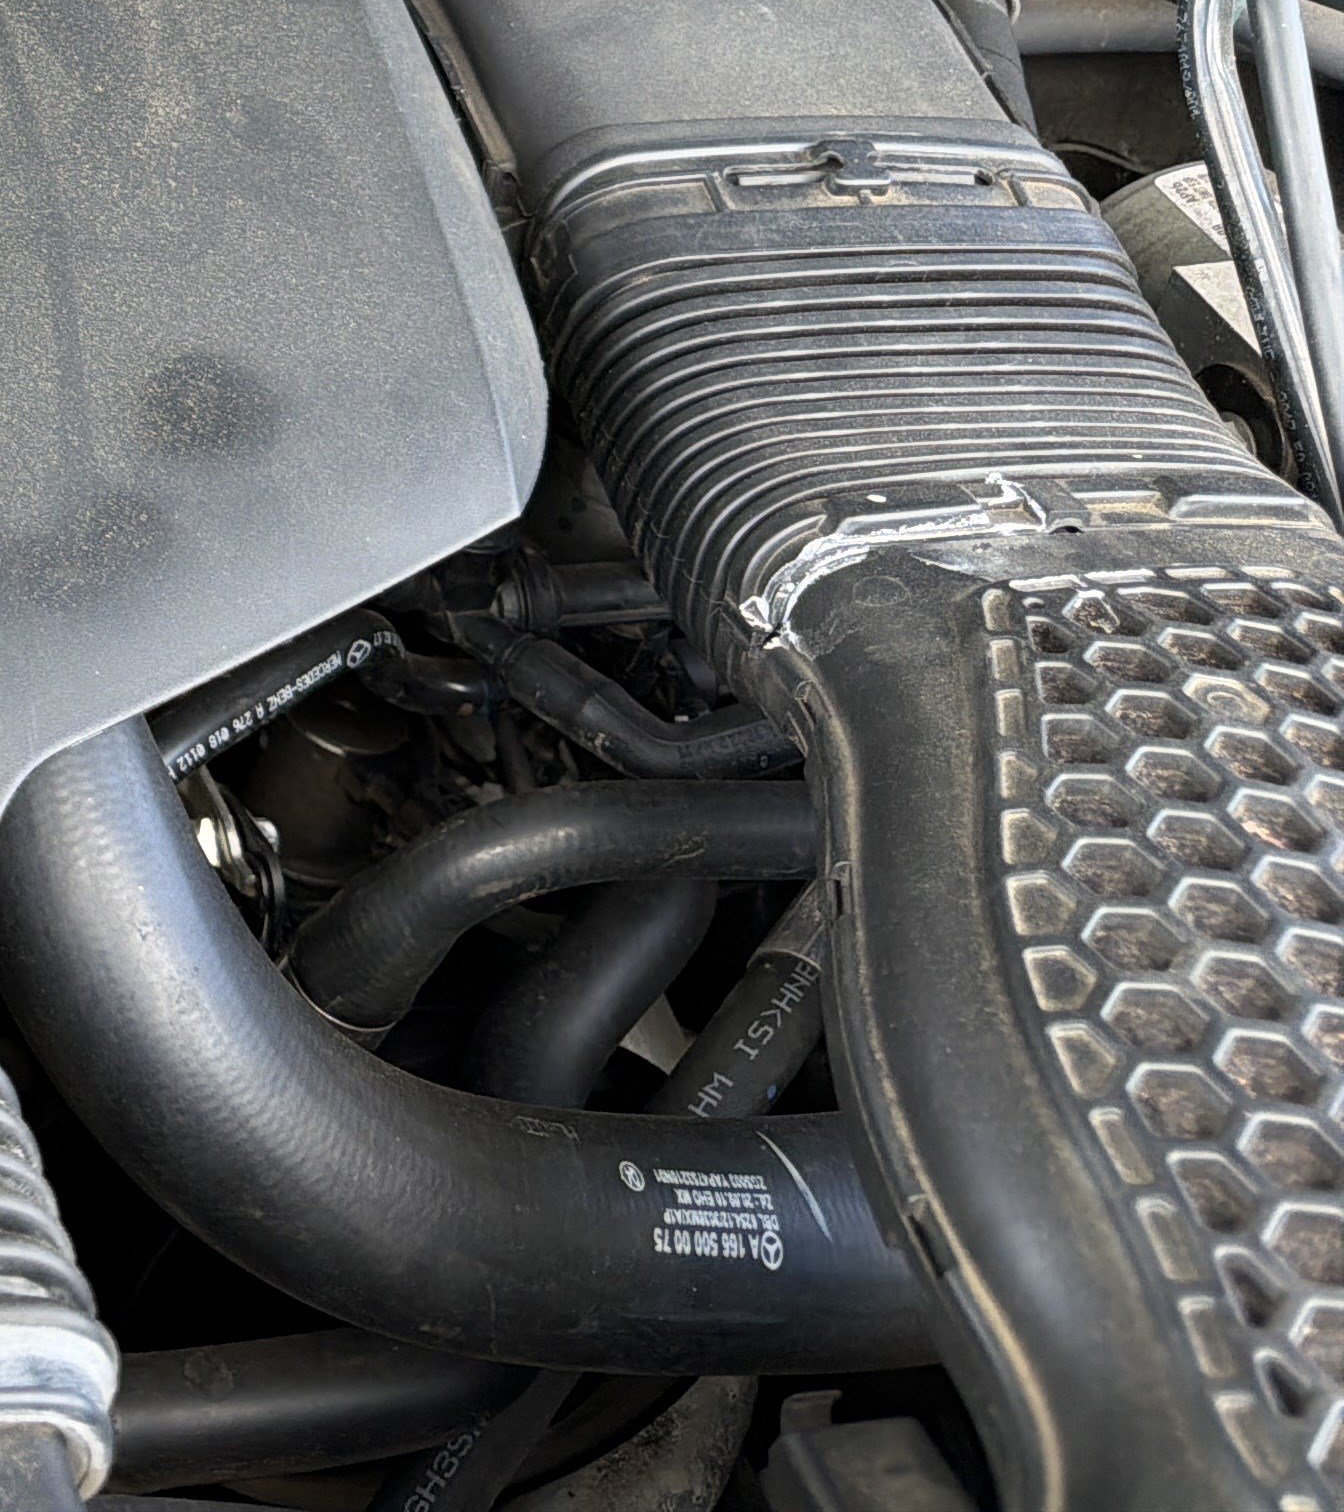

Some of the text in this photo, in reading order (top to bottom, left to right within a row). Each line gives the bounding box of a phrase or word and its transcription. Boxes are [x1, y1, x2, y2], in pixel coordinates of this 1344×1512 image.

[266, 650, 343, 712] MERCEDES-BENZ
[653, 1227, 760, 1260] A 166 500 00 75
